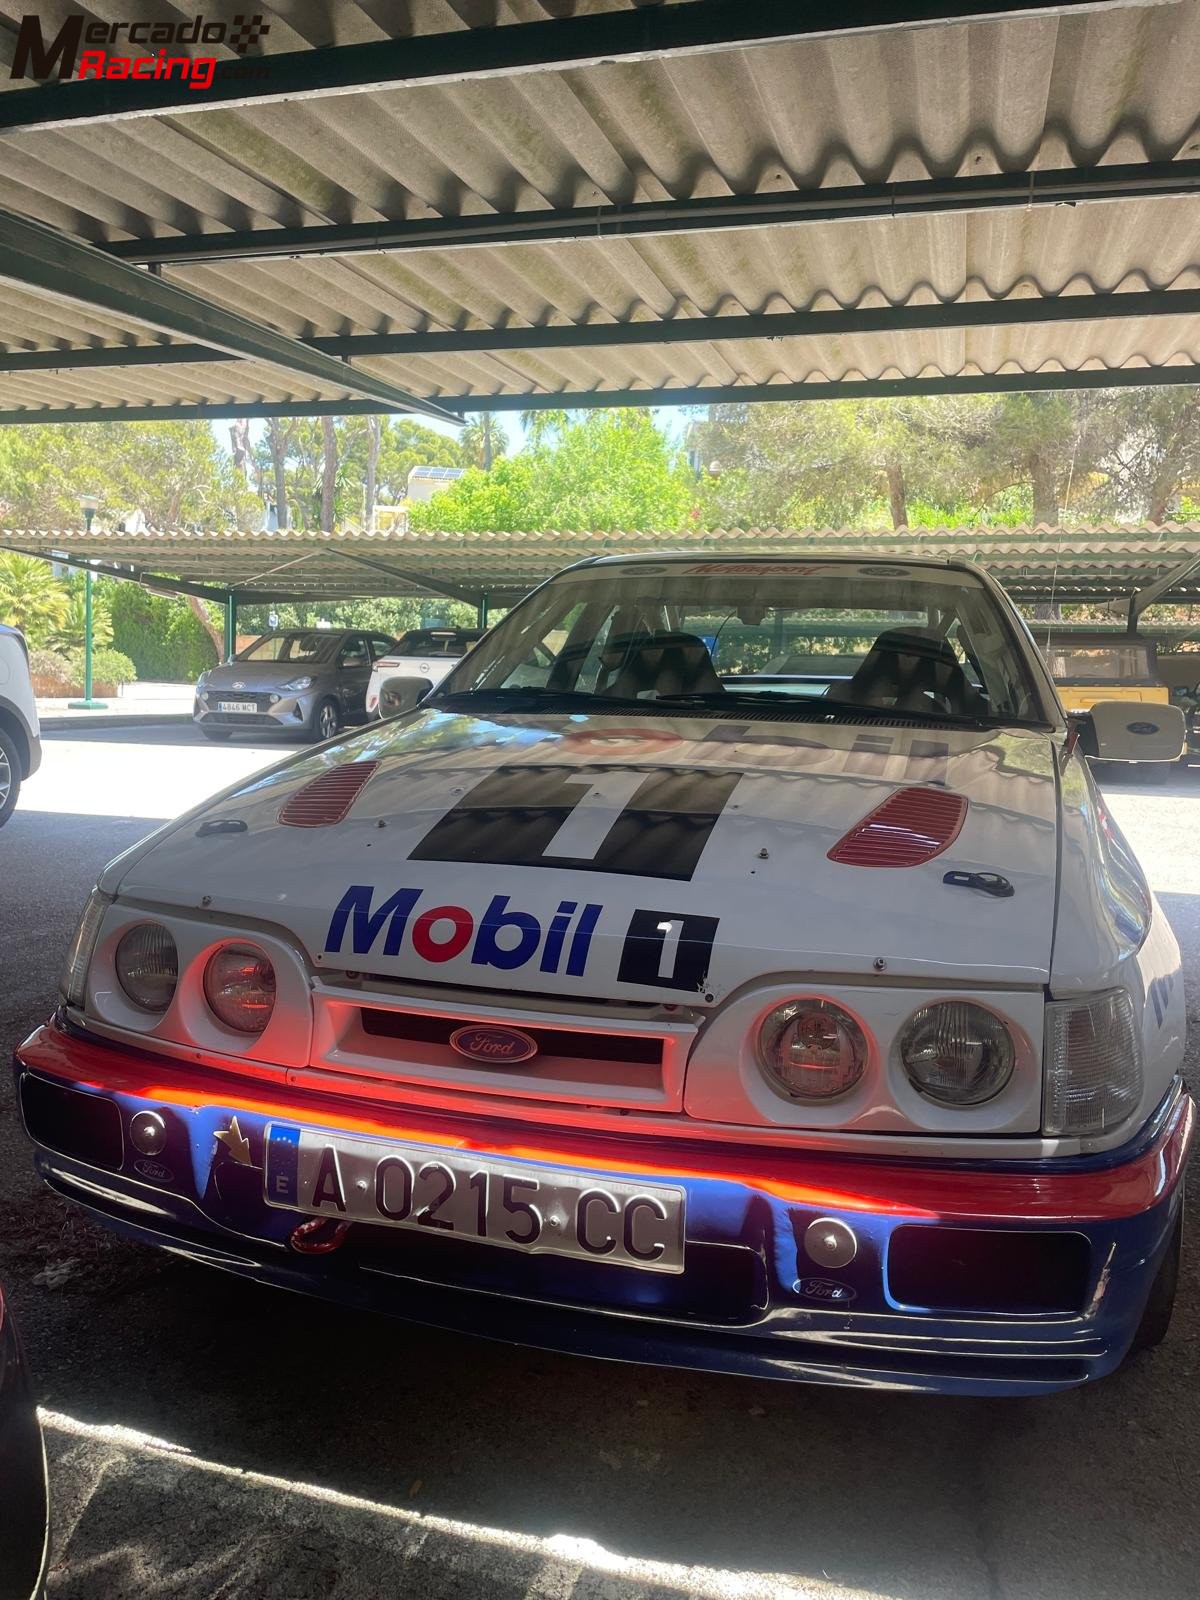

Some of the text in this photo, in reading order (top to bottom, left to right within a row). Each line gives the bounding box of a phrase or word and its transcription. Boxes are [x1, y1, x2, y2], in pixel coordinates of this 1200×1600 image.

[324, 885, 684, 979] Mobil 1
[470, 1032, 516, 1054] Ford
[142, 1160, 165, 1177] Ford
[276, 1175, 289, 1193] E
[311, 1144, 668, 1261] A 0215 CC
[804, 1279, 844, 1298] Ford
